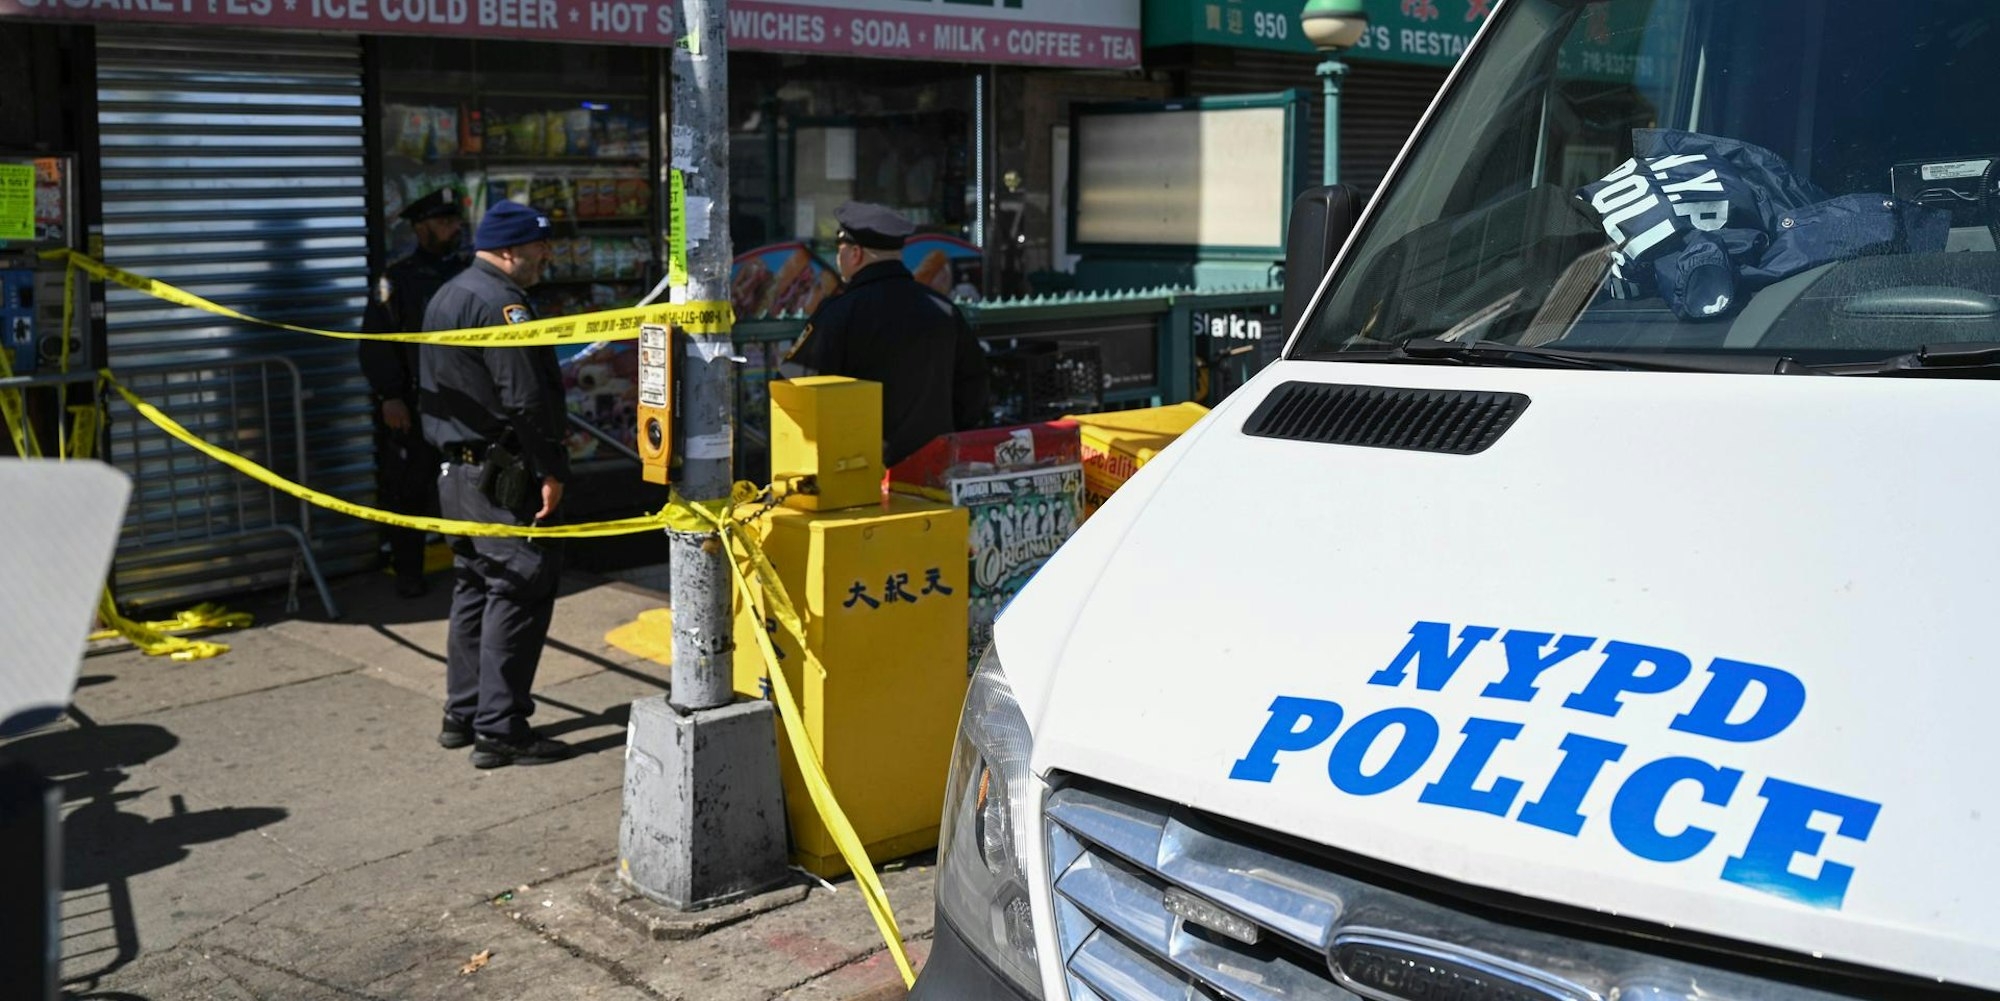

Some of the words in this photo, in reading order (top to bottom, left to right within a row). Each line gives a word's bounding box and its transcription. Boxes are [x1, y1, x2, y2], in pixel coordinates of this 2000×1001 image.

[380, 0, 468, 24] COLD
[478, 0, 559, 29] BEER
[591, 2, 648, 33] HOT
[657, 5, 825, 43] SWICHES
[851, 19, 911, 48] SODA
[934, 24, 986, 52] MILK
[1007, 29, 1081, 58] COFFEE
[1101, 36, 1136, 60] TEA
[1254, 11, 1288, 39] 950
[1357, 26, 1391, 51] G'S
[1591, 157, 1676, 279] POLI
[843, 567, 953, 609] 大紀元
[1367, 620, 1807, 743] NYPD
[1228, 695, 1883, 912] POLICE
